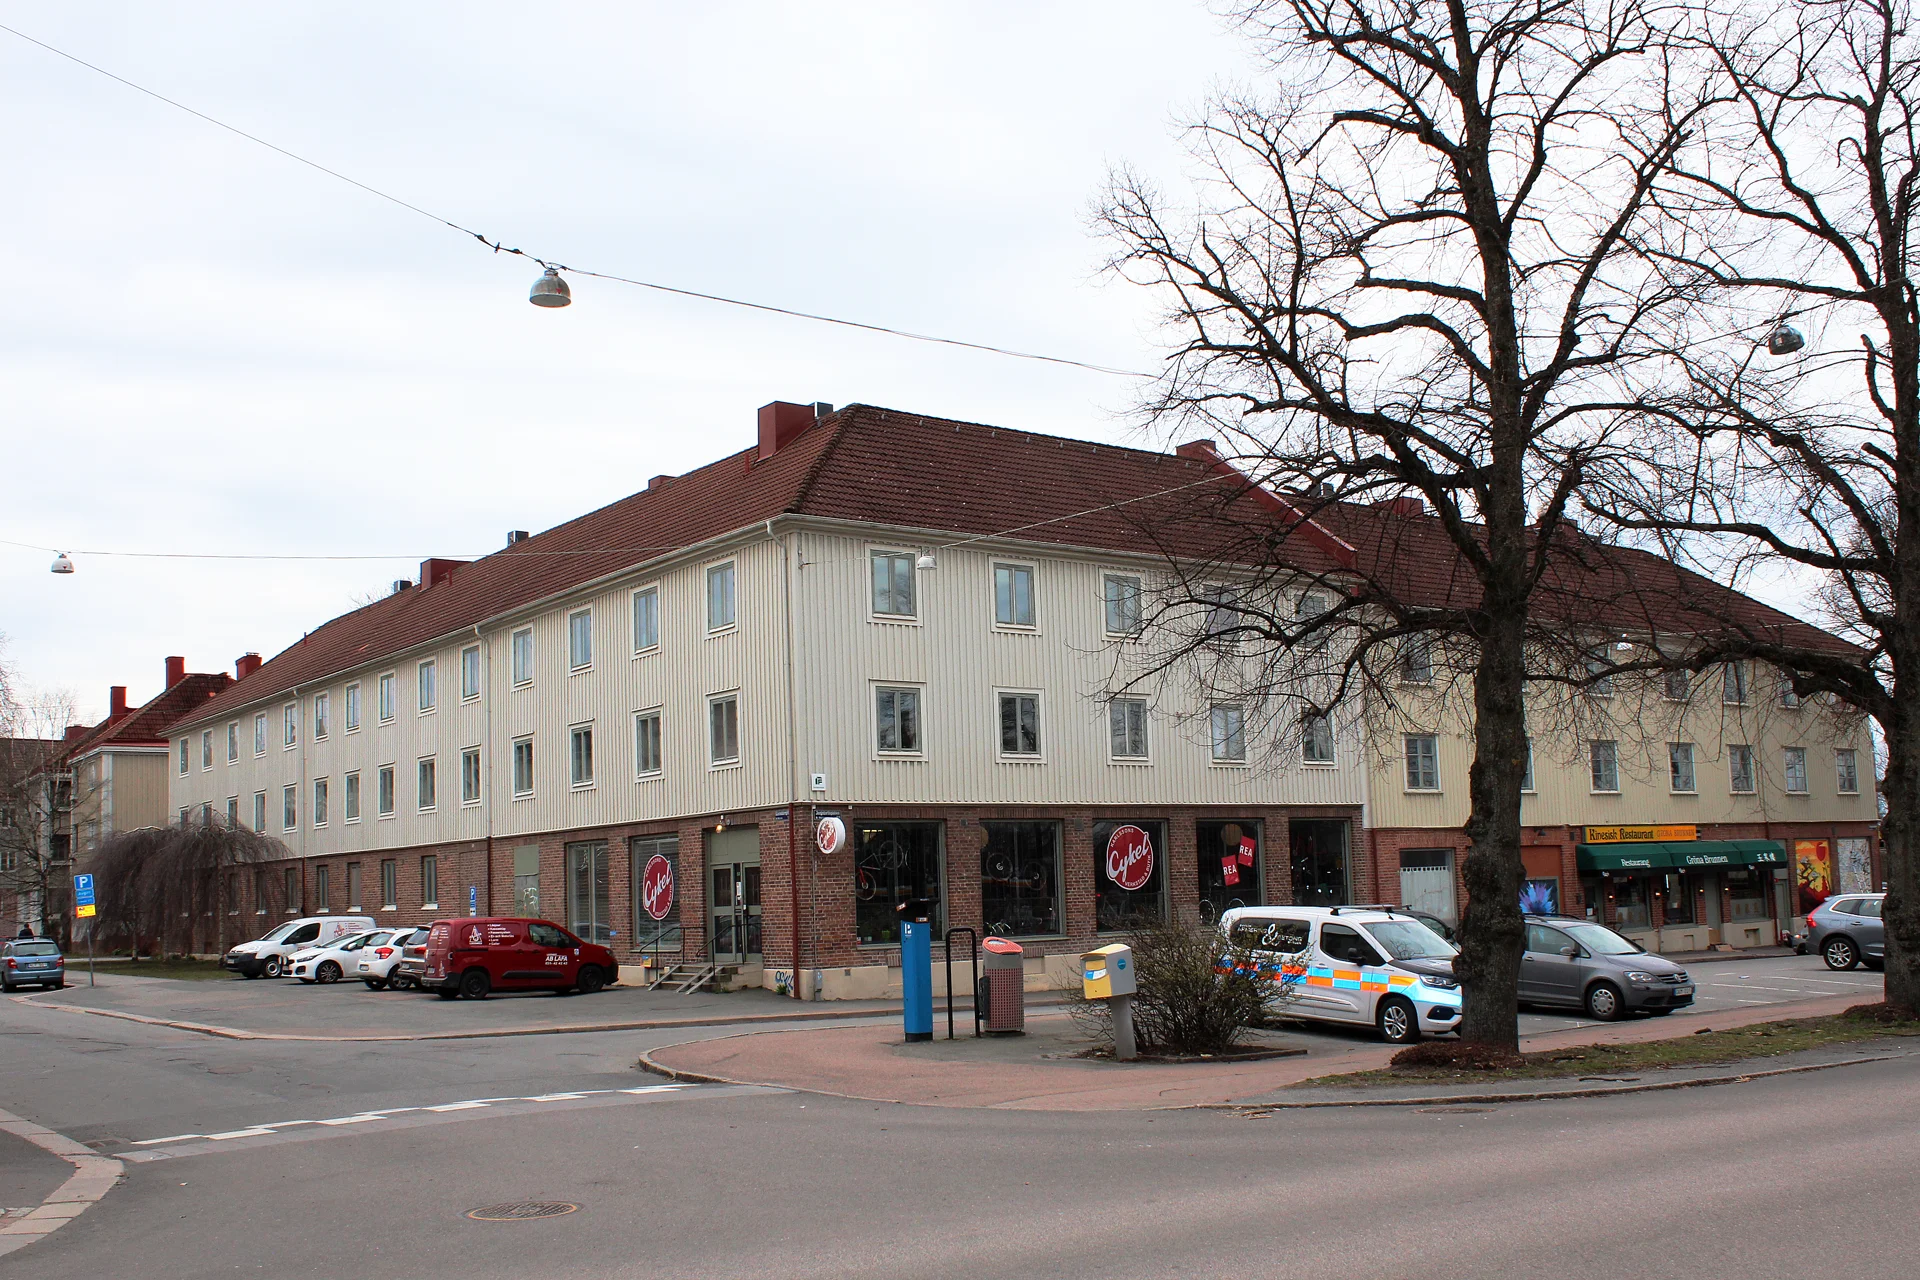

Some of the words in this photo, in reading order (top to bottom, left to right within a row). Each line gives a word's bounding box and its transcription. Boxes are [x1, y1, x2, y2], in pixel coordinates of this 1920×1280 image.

[1589, 828, 1618, 841] Kinesisk
[1620, 828, 1654, 840] Restaurant
[1239, 845, 1253, 857] REA
[1108, 833, 1149, 883] Cykel
[1686, 855, 1704, 865] Gröna
[1704, 854, 1728, 864] Brunnen
[1223, 864, 1237, 876] REA
[79, 876, 88, 888] P
[644, 860, 673, 913] Cykel
[470, 888, 475, 900] P
